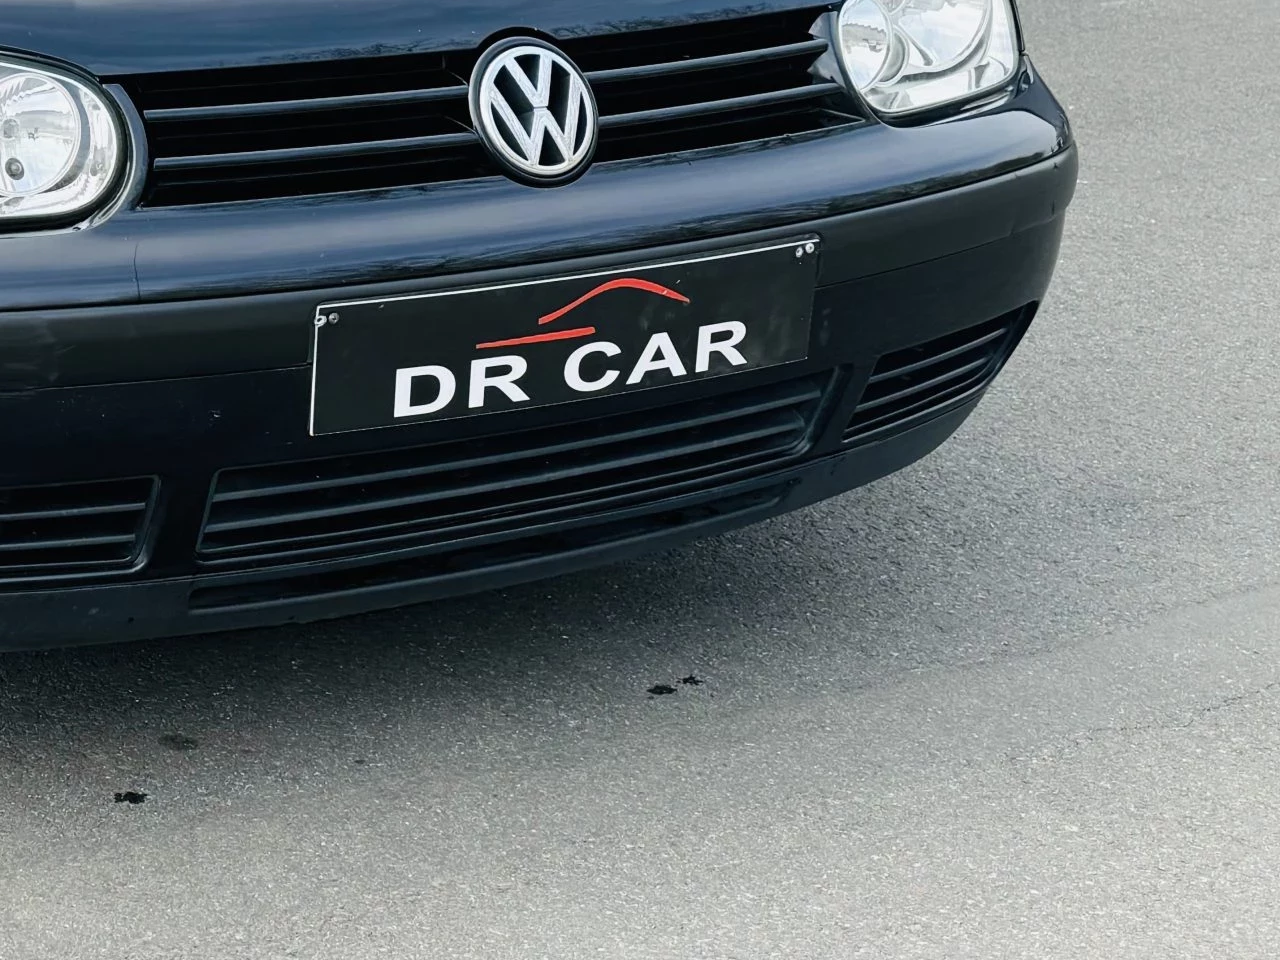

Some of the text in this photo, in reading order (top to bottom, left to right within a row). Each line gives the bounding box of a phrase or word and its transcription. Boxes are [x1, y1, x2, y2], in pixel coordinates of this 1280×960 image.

[481, 46, 592, 174] VW
[393, 320, 749, 419] DR CAR
